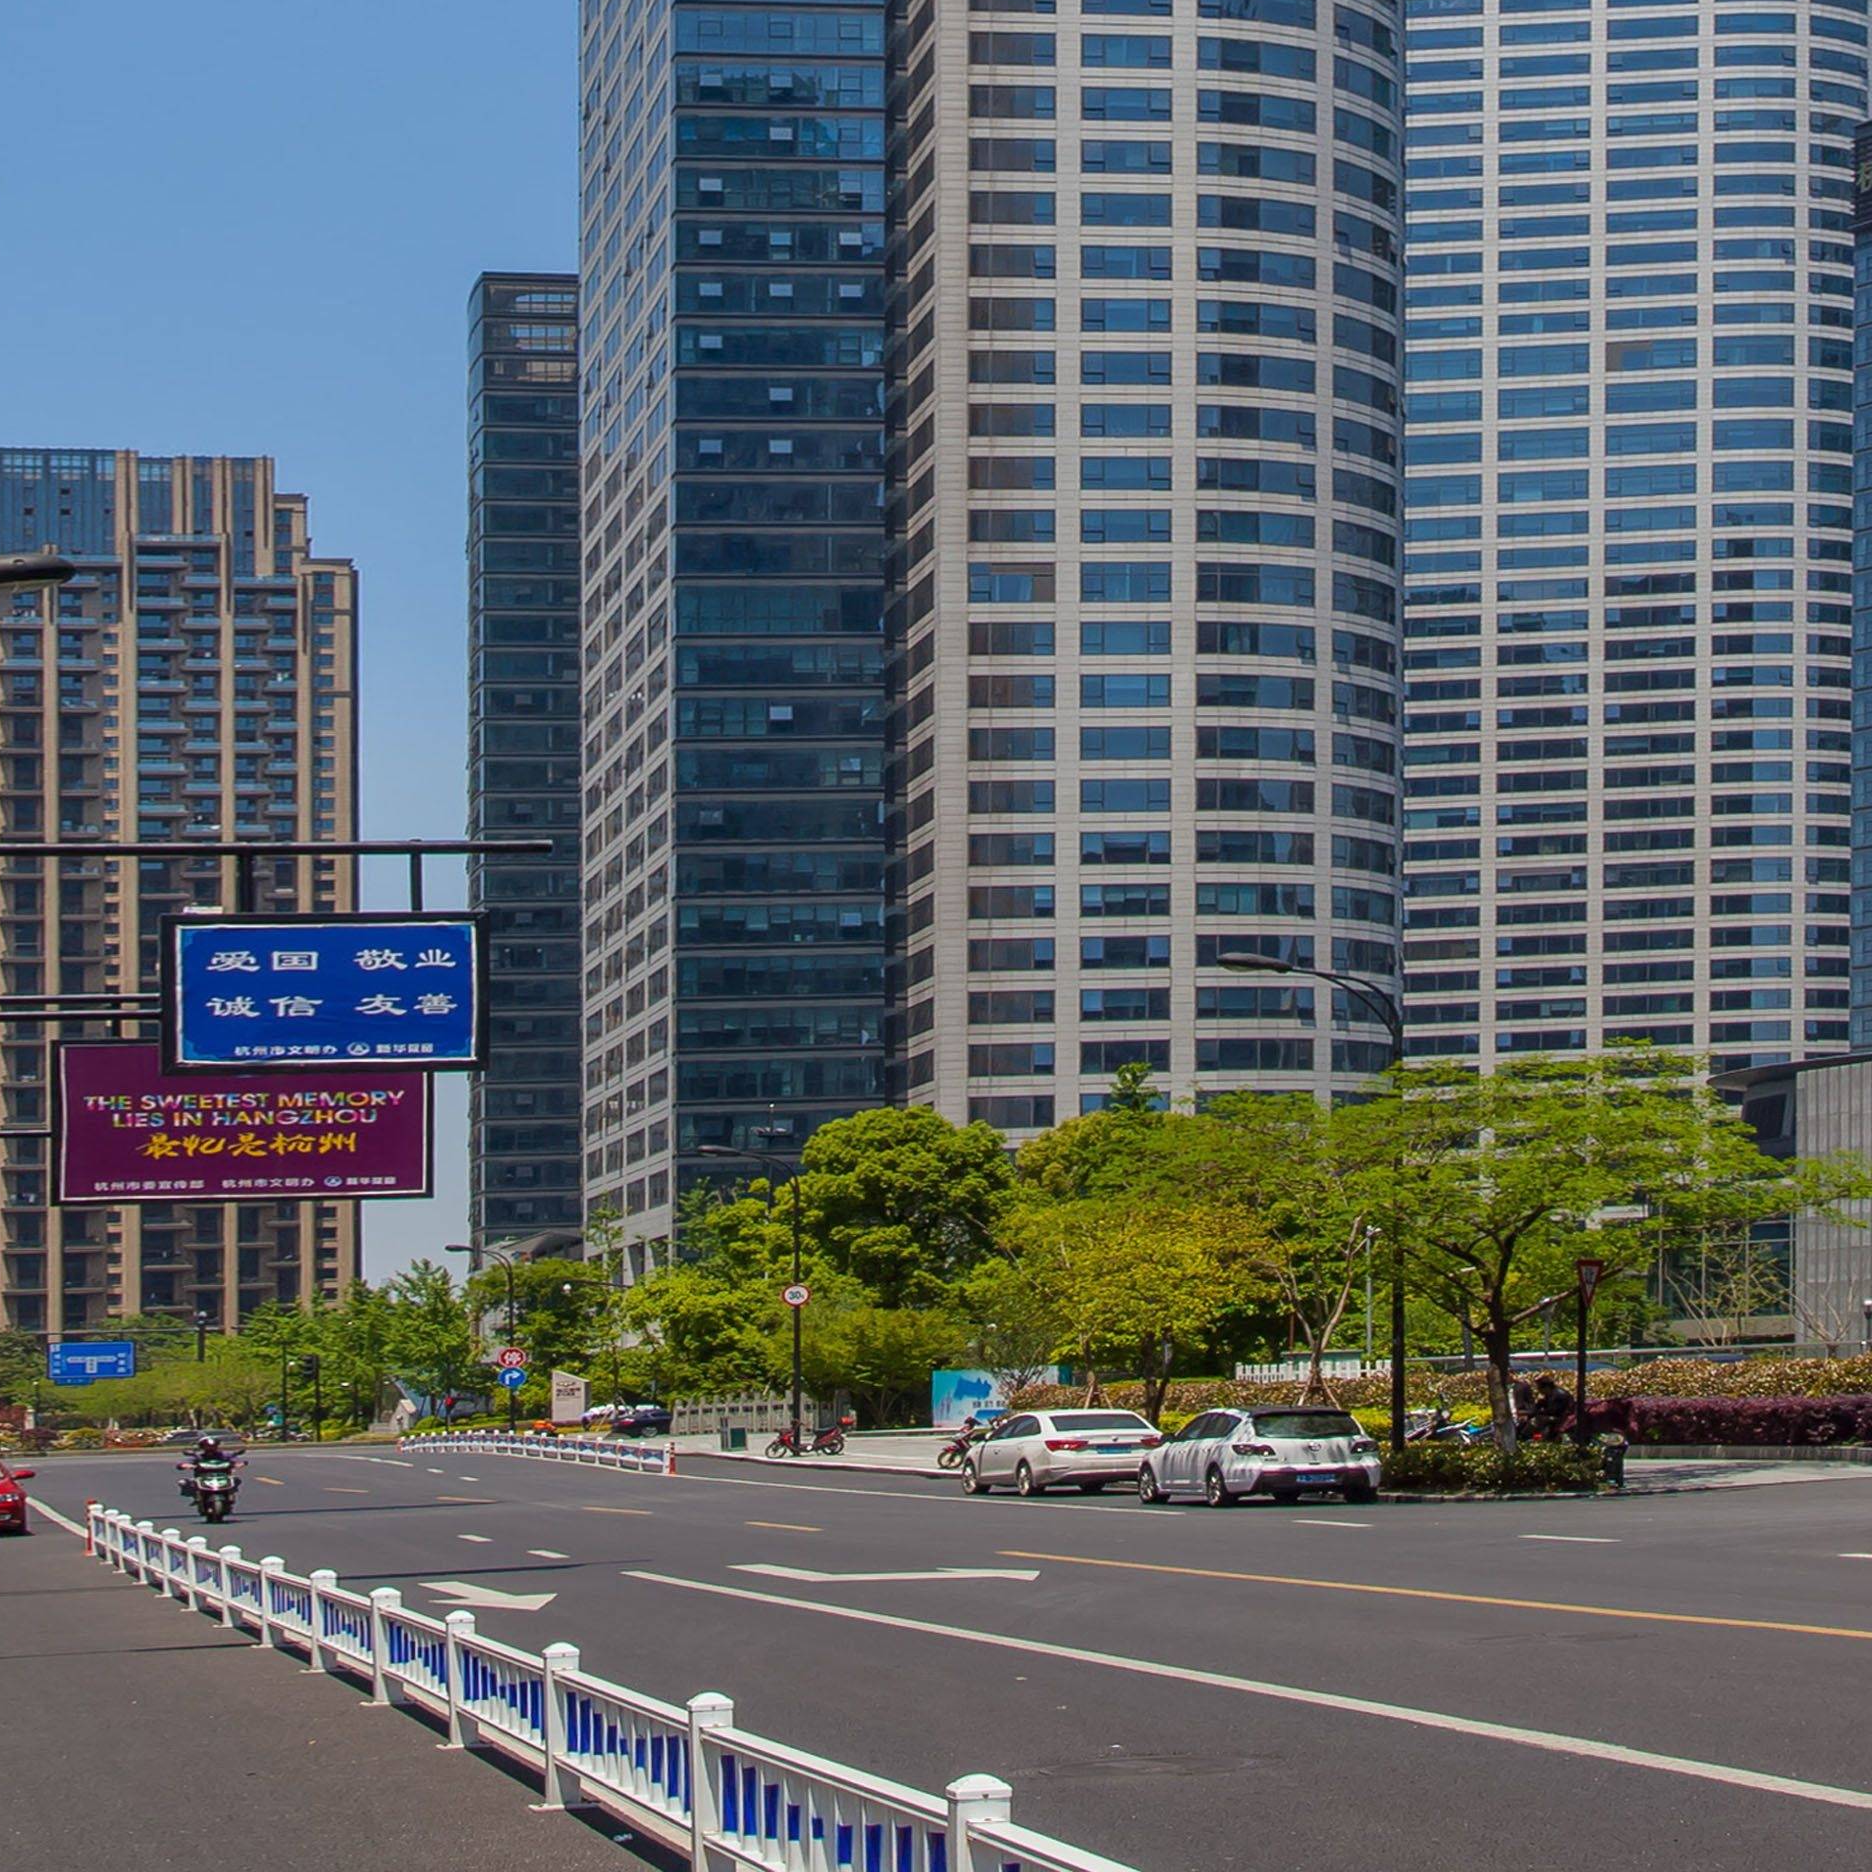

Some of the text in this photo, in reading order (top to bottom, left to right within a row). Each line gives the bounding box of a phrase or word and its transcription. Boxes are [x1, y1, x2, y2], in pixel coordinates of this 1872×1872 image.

[206, 948, 457, 972] 爱国 敬业
[206, 993, 458, 1018] 诚信 友善
[83, 1090, 405, 1111] THE SWEETEST MEMORY
[113, 1109, 377, 1128] LIES IN HANGZHOU
[135, 1132, 358, 1160] 最忆是杭州
